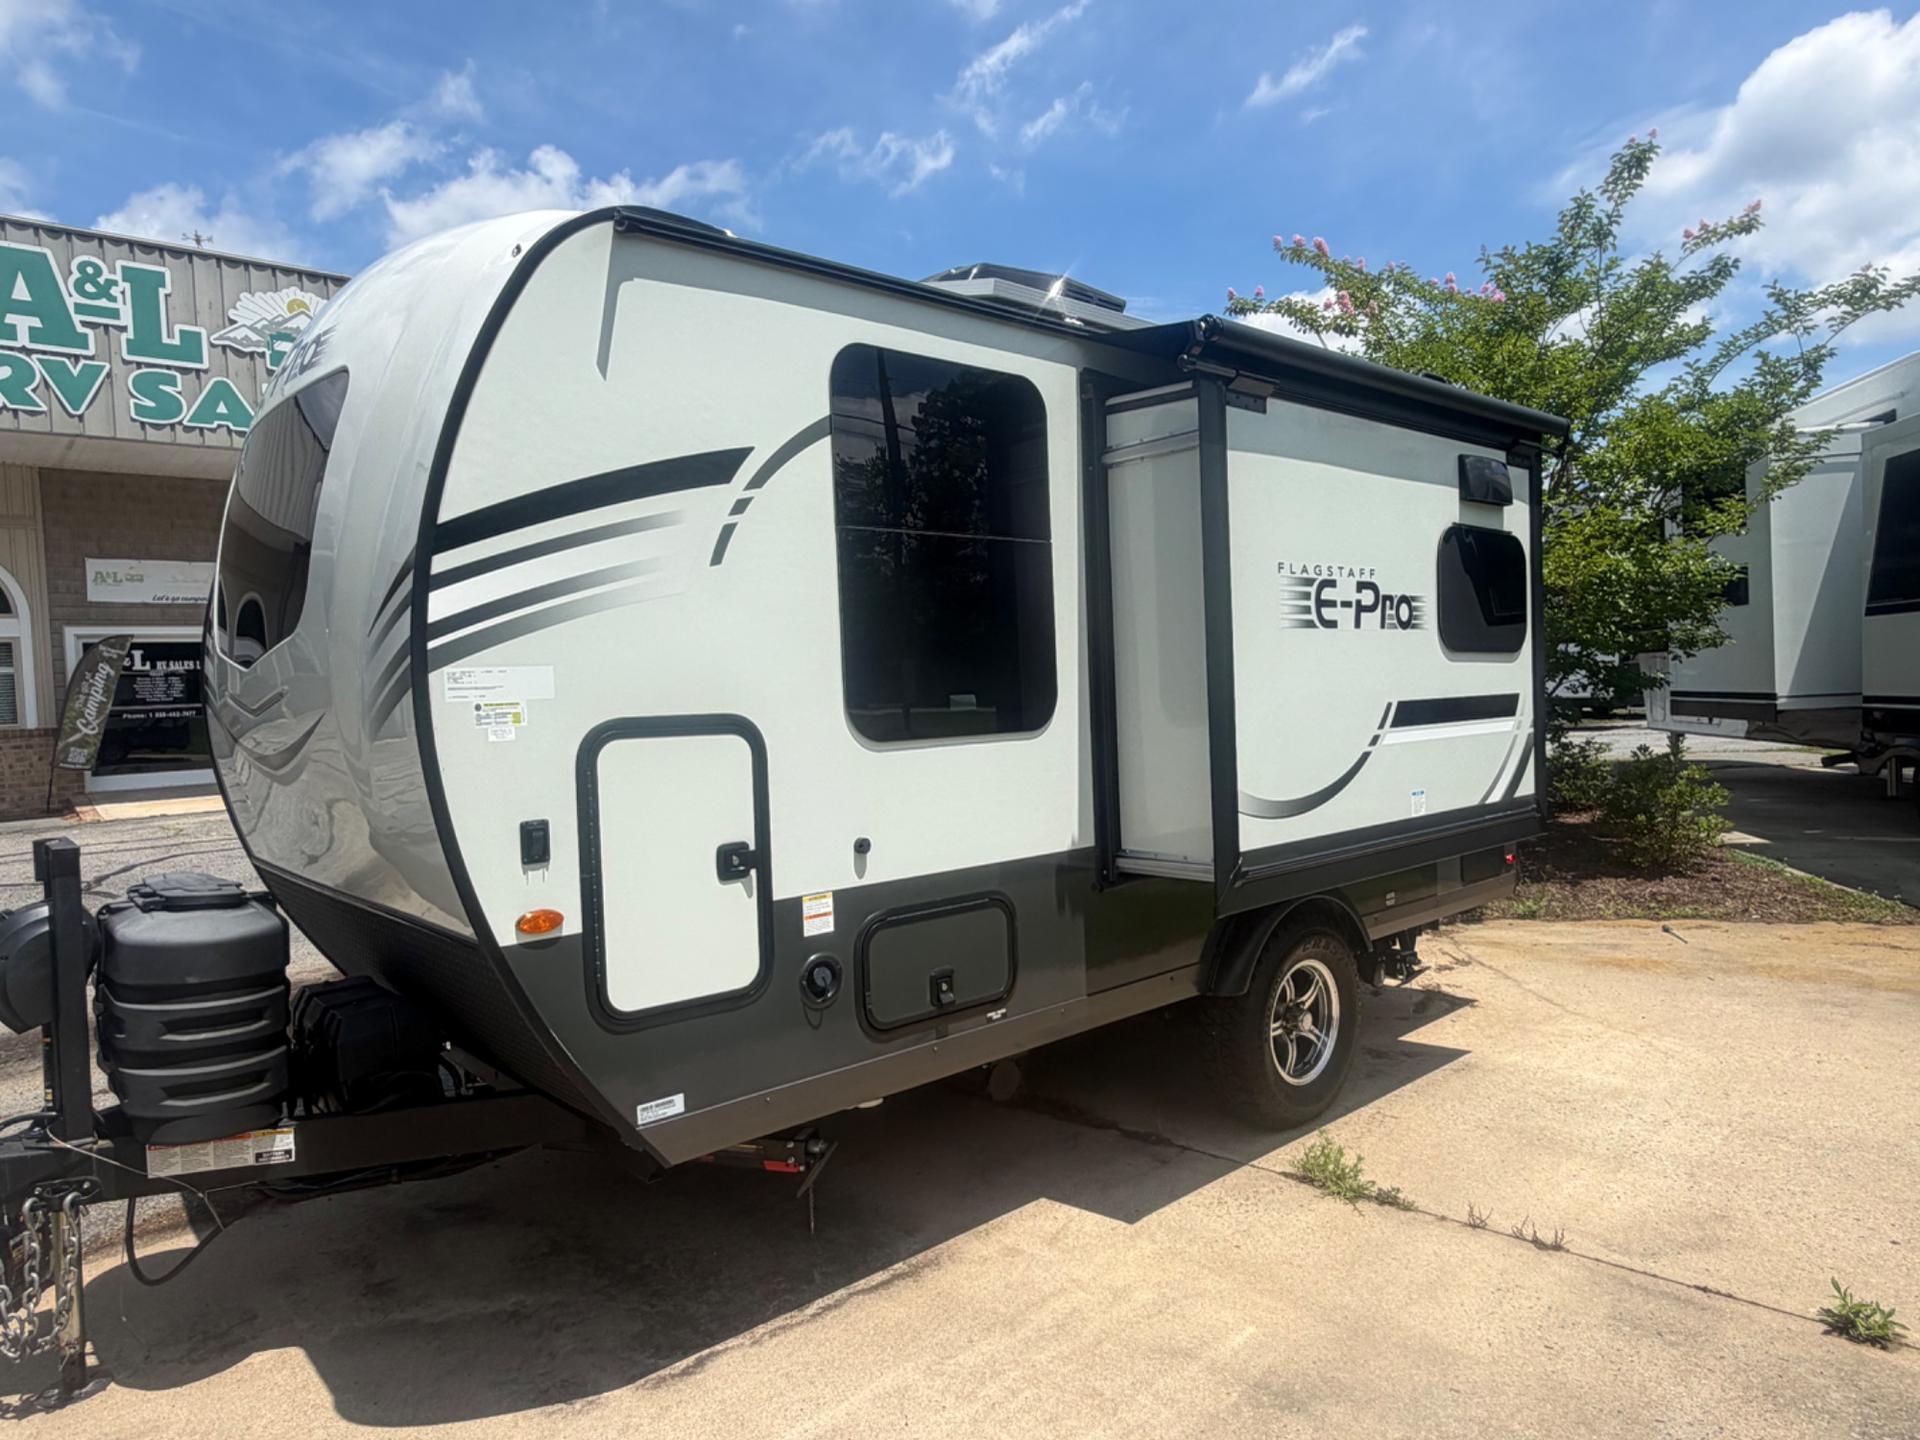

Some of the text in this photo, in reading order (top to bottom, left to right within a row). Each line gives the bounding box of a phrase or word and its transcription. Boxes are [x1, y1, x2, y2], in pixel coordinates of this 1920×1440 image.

[0, 243, 208, 369] A&L
[0, 351, 254, 432] RV SA
[1278, 562, 1376, 579] FLAGSTAFF
[1315, 579, 1413, 630] E-Pro
[76, 661, 115, 735] Camping
